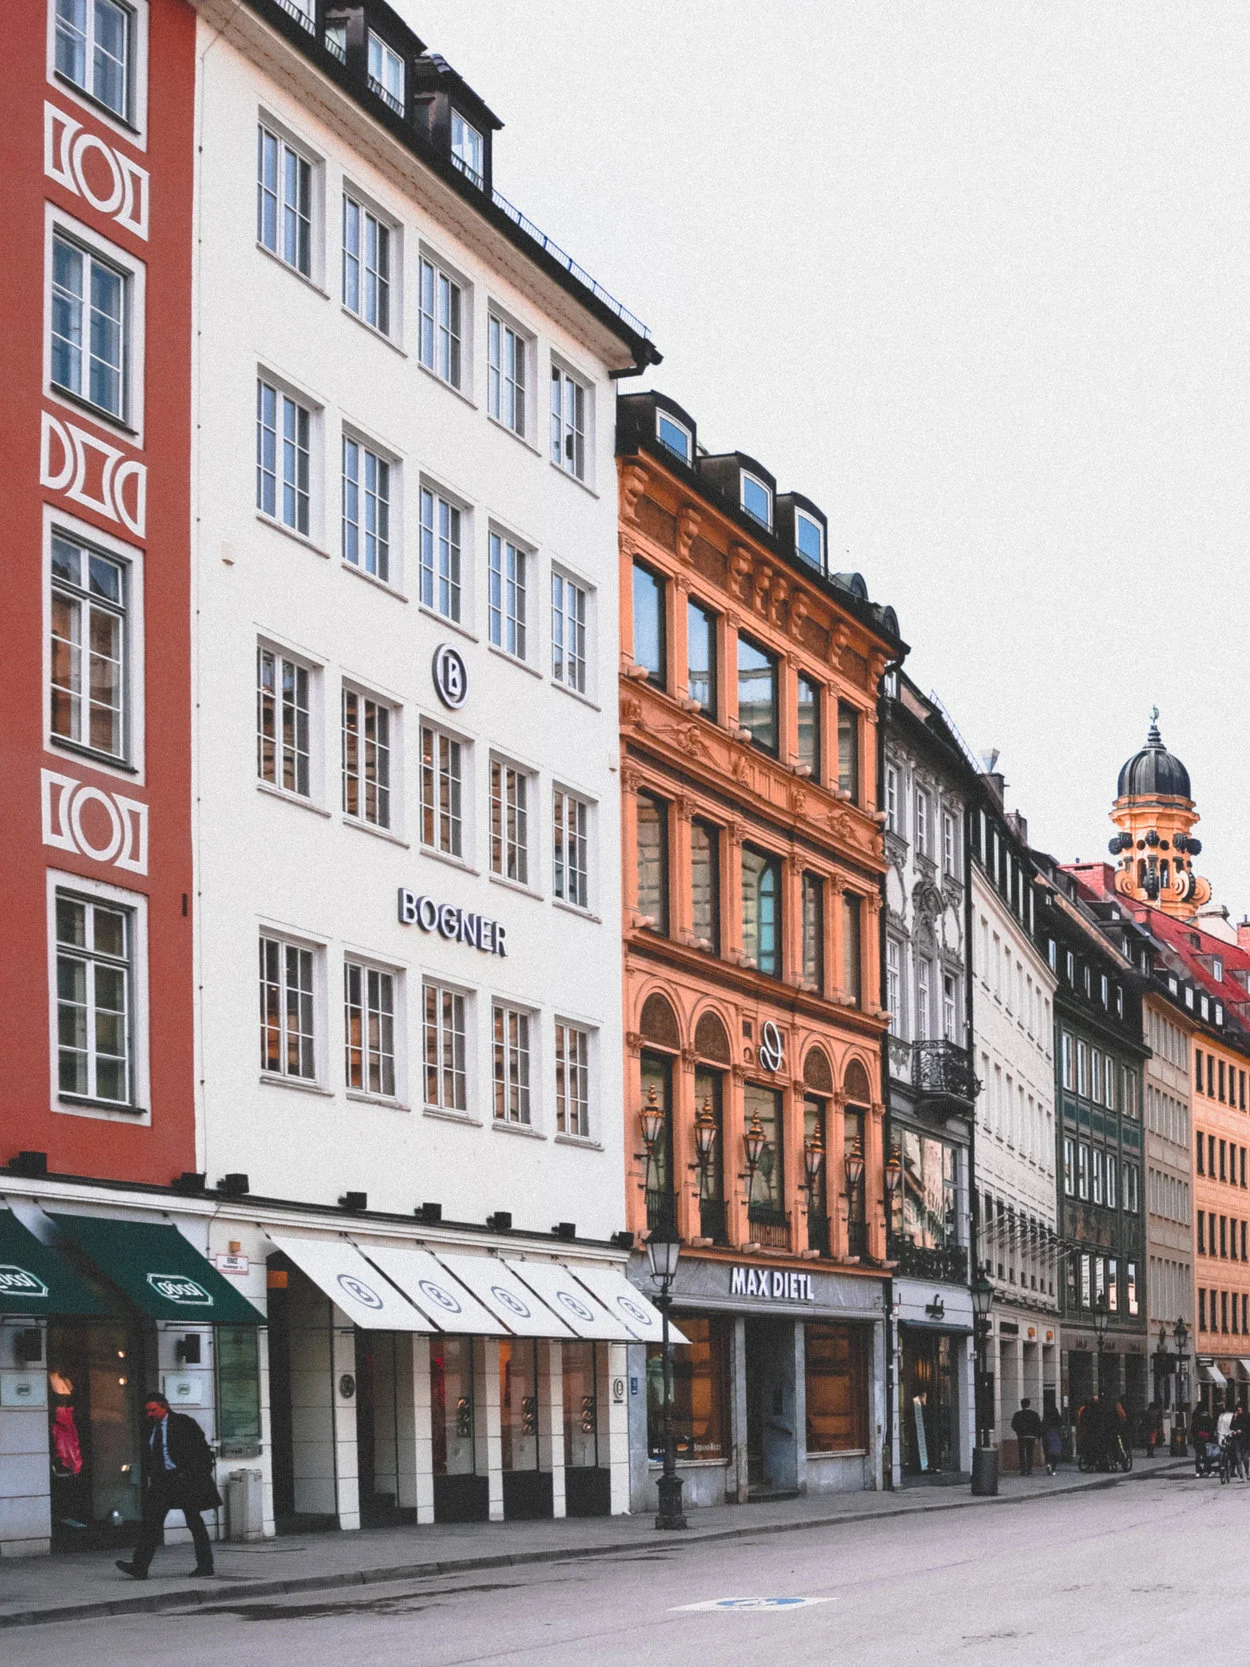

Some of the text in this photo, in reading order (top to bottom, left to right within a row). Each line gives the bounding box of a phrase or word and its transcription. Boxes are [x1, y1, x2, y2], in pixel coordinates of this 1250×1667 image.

[398, 887, 507, 957] BOGNER
[730, 1267, 815, 1300] MAX DIETL
